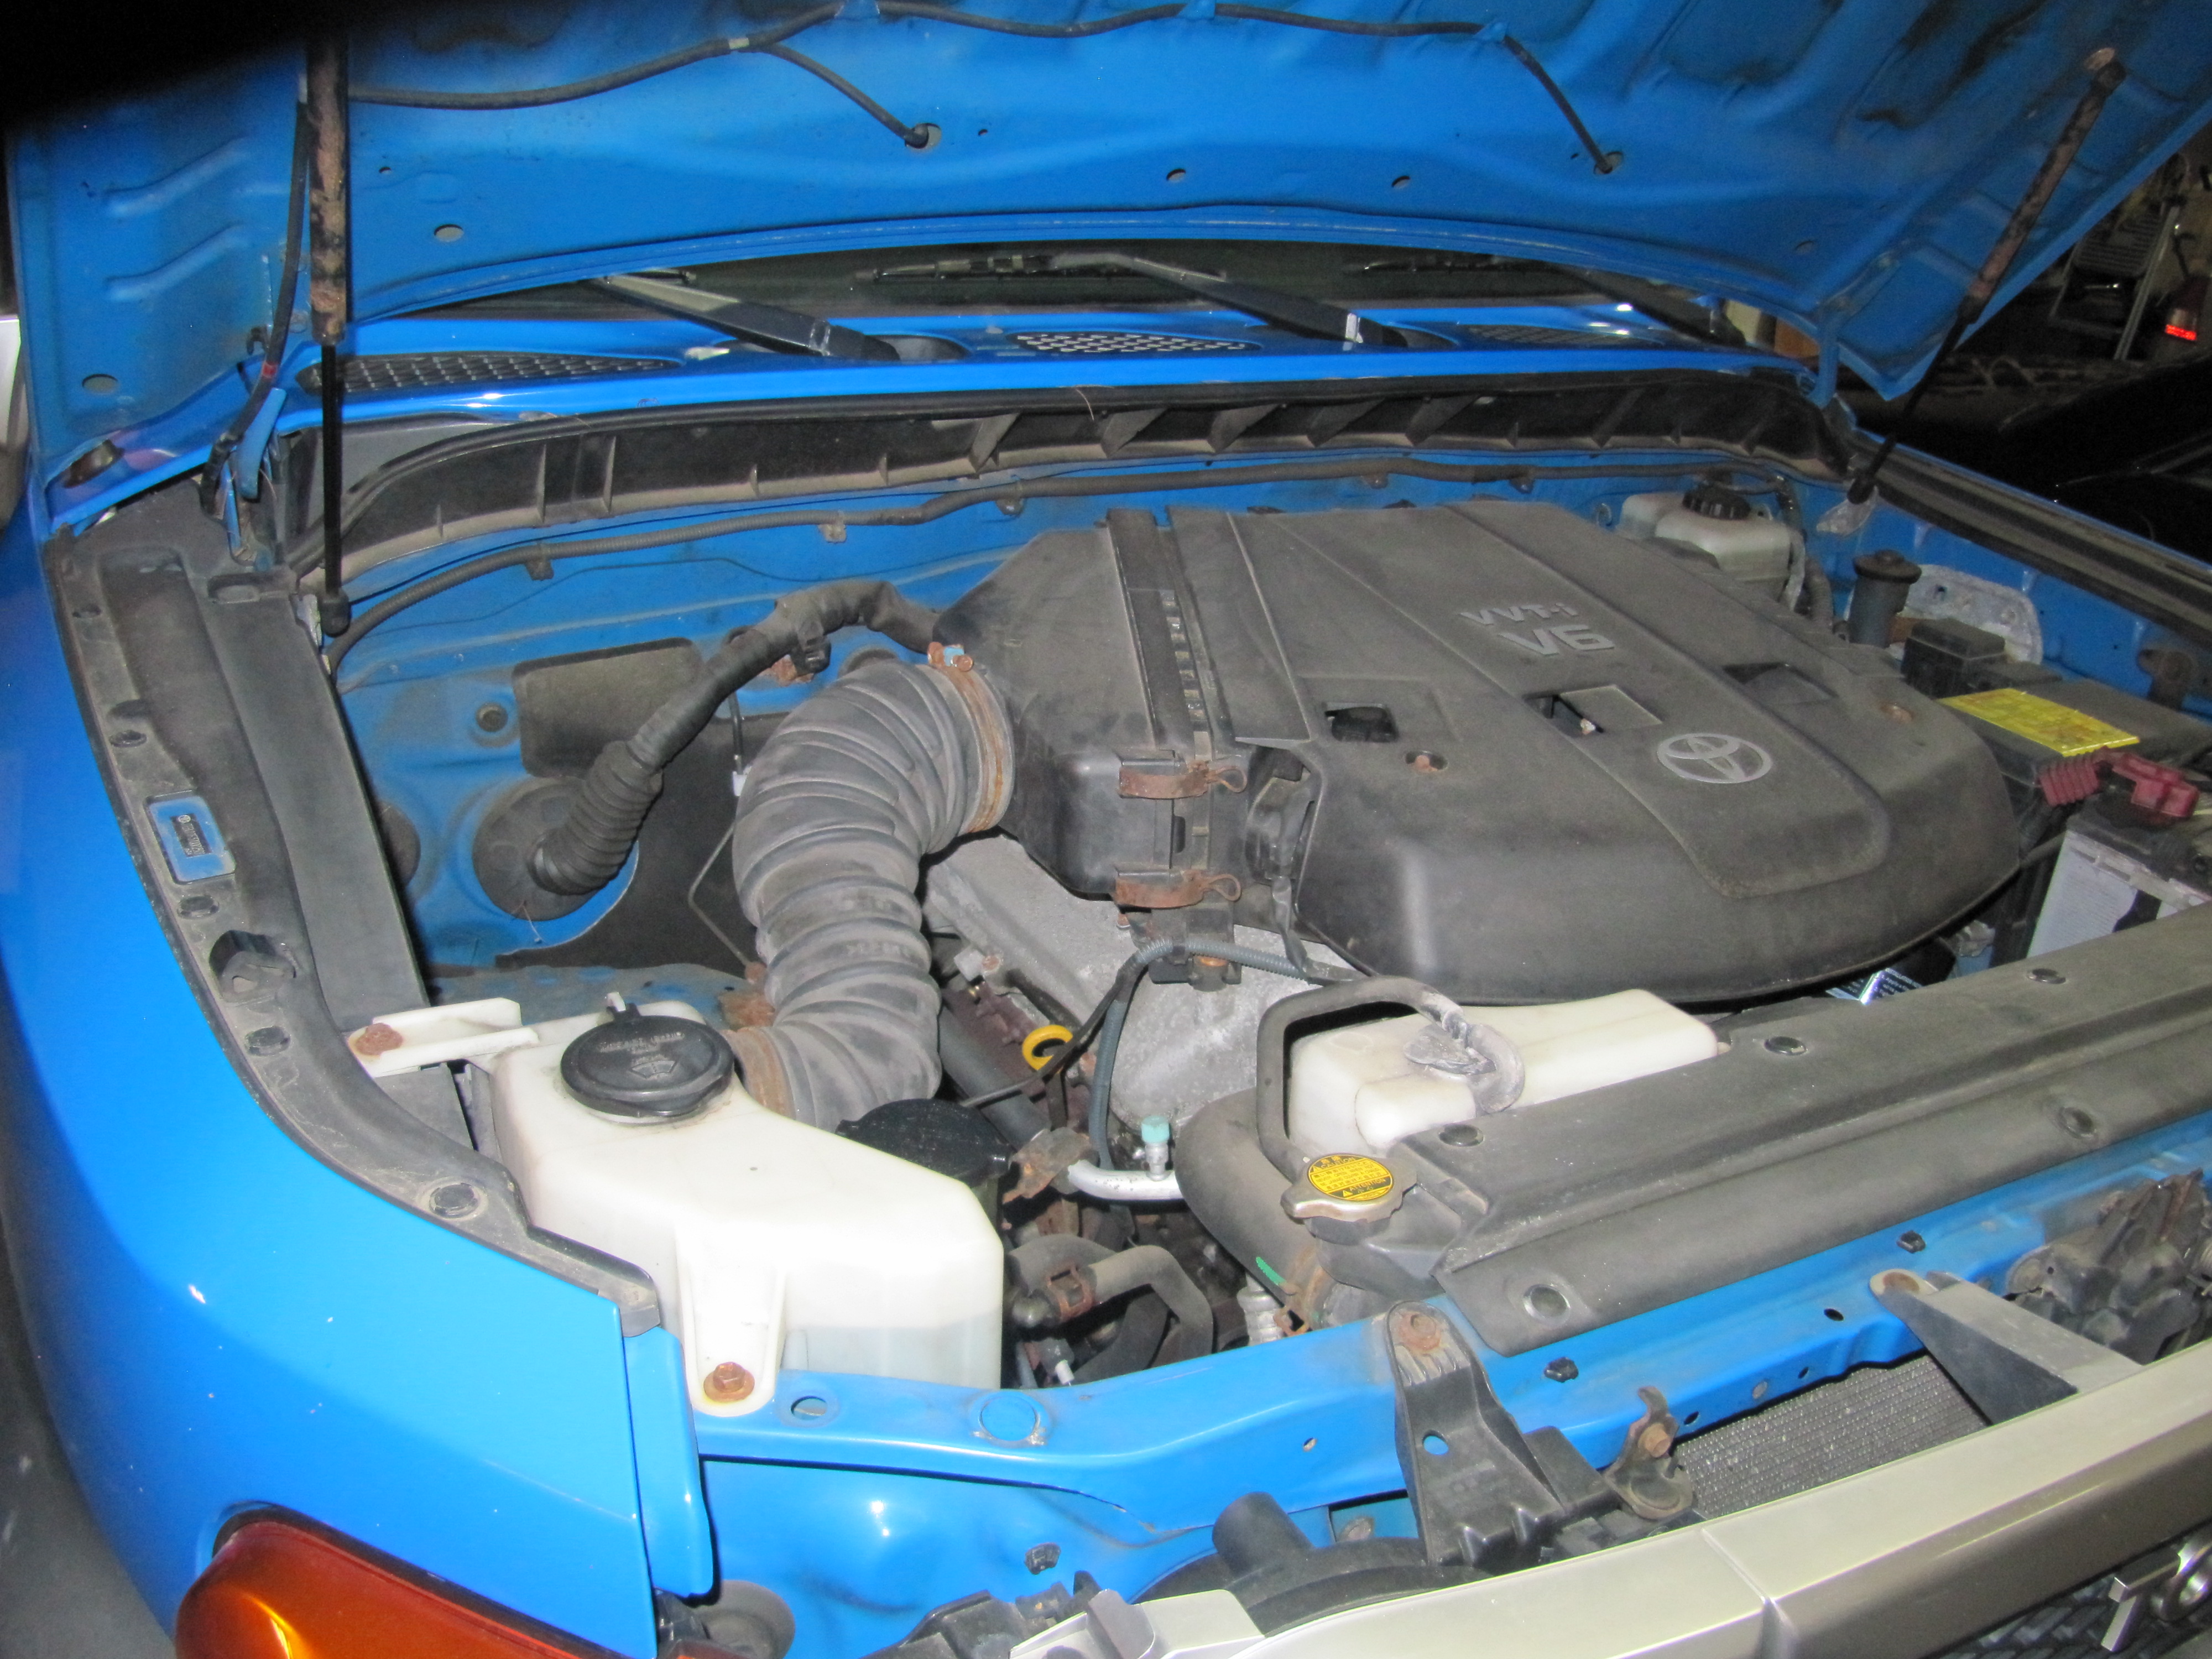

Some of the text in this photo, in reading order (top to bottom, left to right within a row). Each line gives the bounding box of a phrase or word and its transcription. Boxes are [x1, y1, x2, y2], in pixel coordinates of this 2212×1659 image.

[1457, 602, 1579, 625] VVT-i
[1498, 624, 1615, 656] V6
[1321, 1157, 1356, 1168] CAUTION
[1349, 1178, 1386, 1191] ATTENTION
